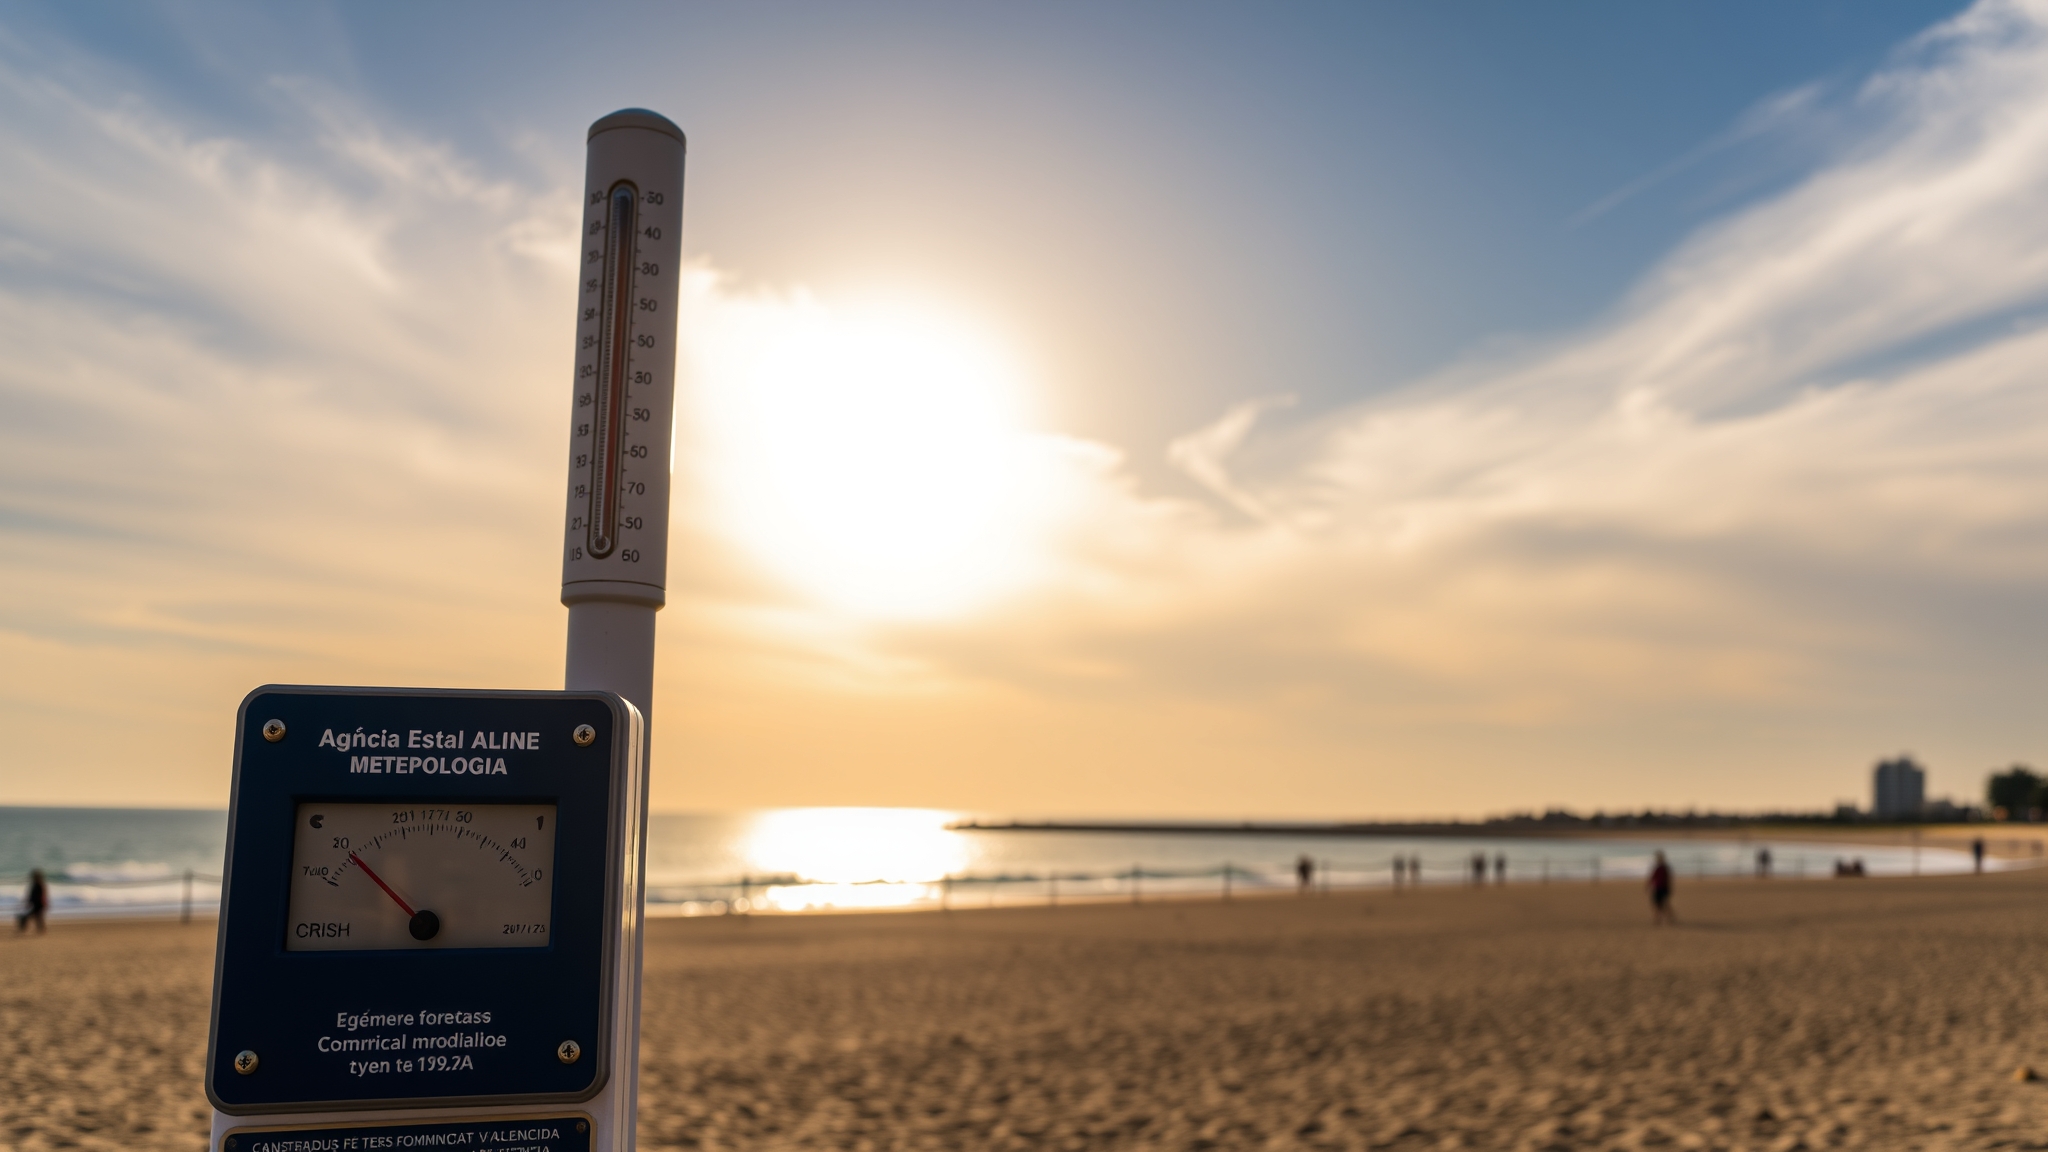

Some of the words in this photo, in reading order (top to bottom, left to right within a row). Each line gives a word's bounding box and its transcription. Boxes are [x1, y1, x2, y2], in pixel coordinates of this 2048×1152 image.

[644, 226, 661, 240] 40
[627, 482, 645, 495] 70
[407, 730, 464, 749] Estal
[471, 731, 540, 750] ALINE
[350, 756, 508, 775] METEPOLOGIA
[296, 923, 350, 938] CRISH
[419, 1010, 492, 1025] foretass
[349, 1060, 391, 1077] tyen
[396, 1059, 413, 1073] te
[478, 1128, 560, 1143] VALENCIDA
